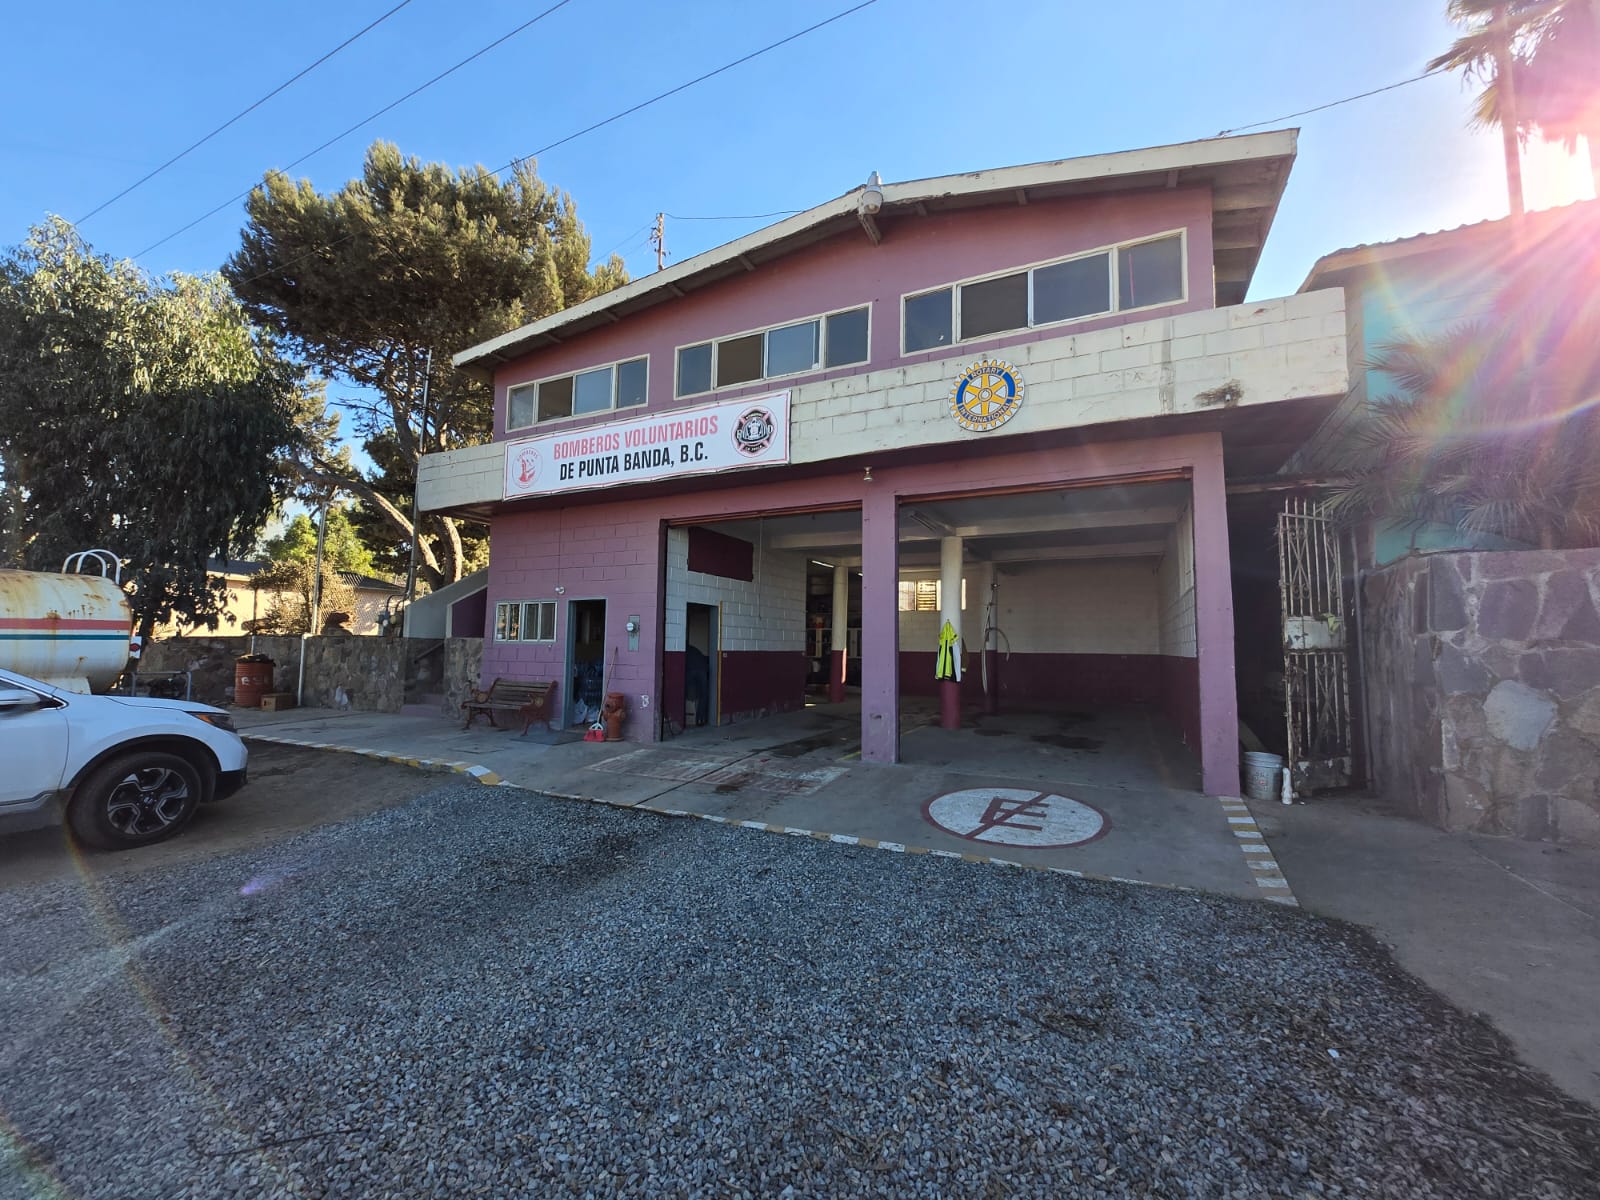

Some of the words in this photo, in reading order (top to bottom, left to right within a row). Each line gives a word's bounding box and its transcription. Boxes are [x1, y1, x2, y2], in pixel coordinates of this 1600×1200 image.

[972, 366, 1001, 378] ROTARY
[959, 402, 1010, 424] INTERNATIONAL
[553, 433, 620, 460] BOMBEROS
[624, 415, 719, 449] VOLUNTARIOS
[559, 462, 575, 481] DE
[578, 455, 620, 478] PUNTA
[623, 447, 675, 472] BANDA,
[680, 441, 709, 463] B.C.
